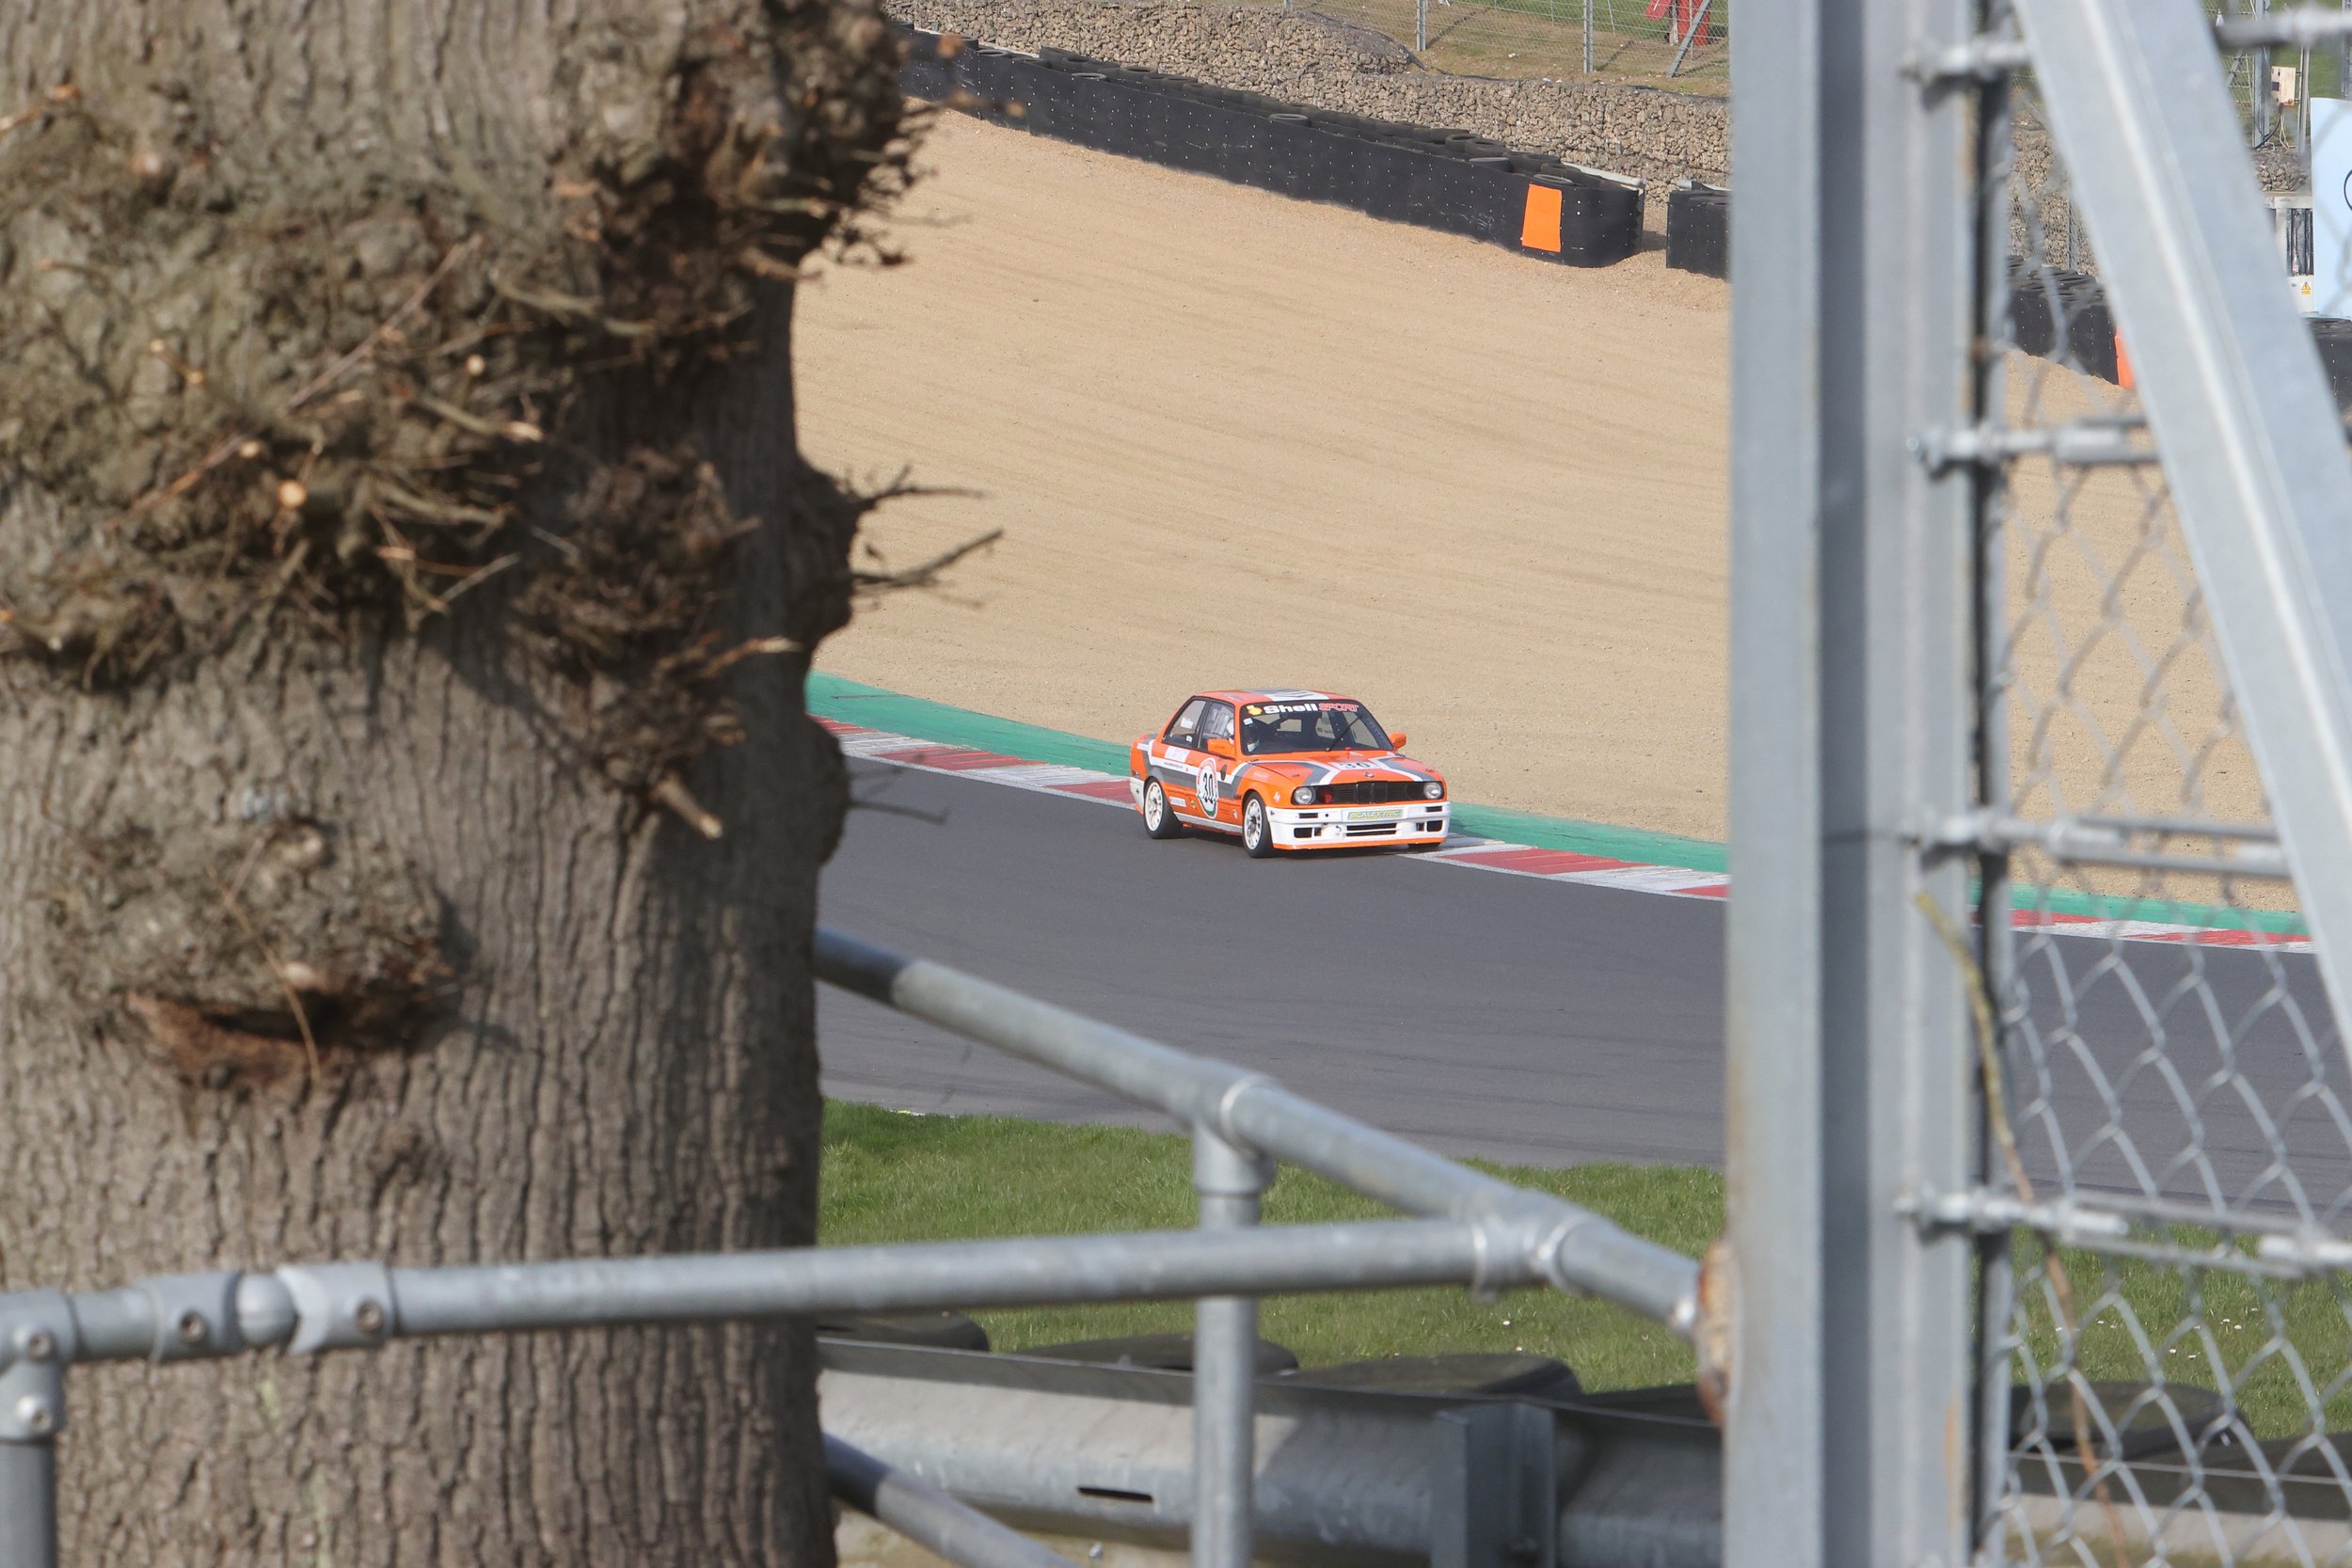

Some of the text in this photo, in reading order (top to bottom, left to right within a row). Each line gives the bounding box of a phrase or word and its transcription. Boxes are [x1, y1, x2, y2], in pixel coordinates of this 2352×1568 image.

[1263, 703, 1359, 714] Shell SPORT
[1203, 772, 1215, 804] 30
